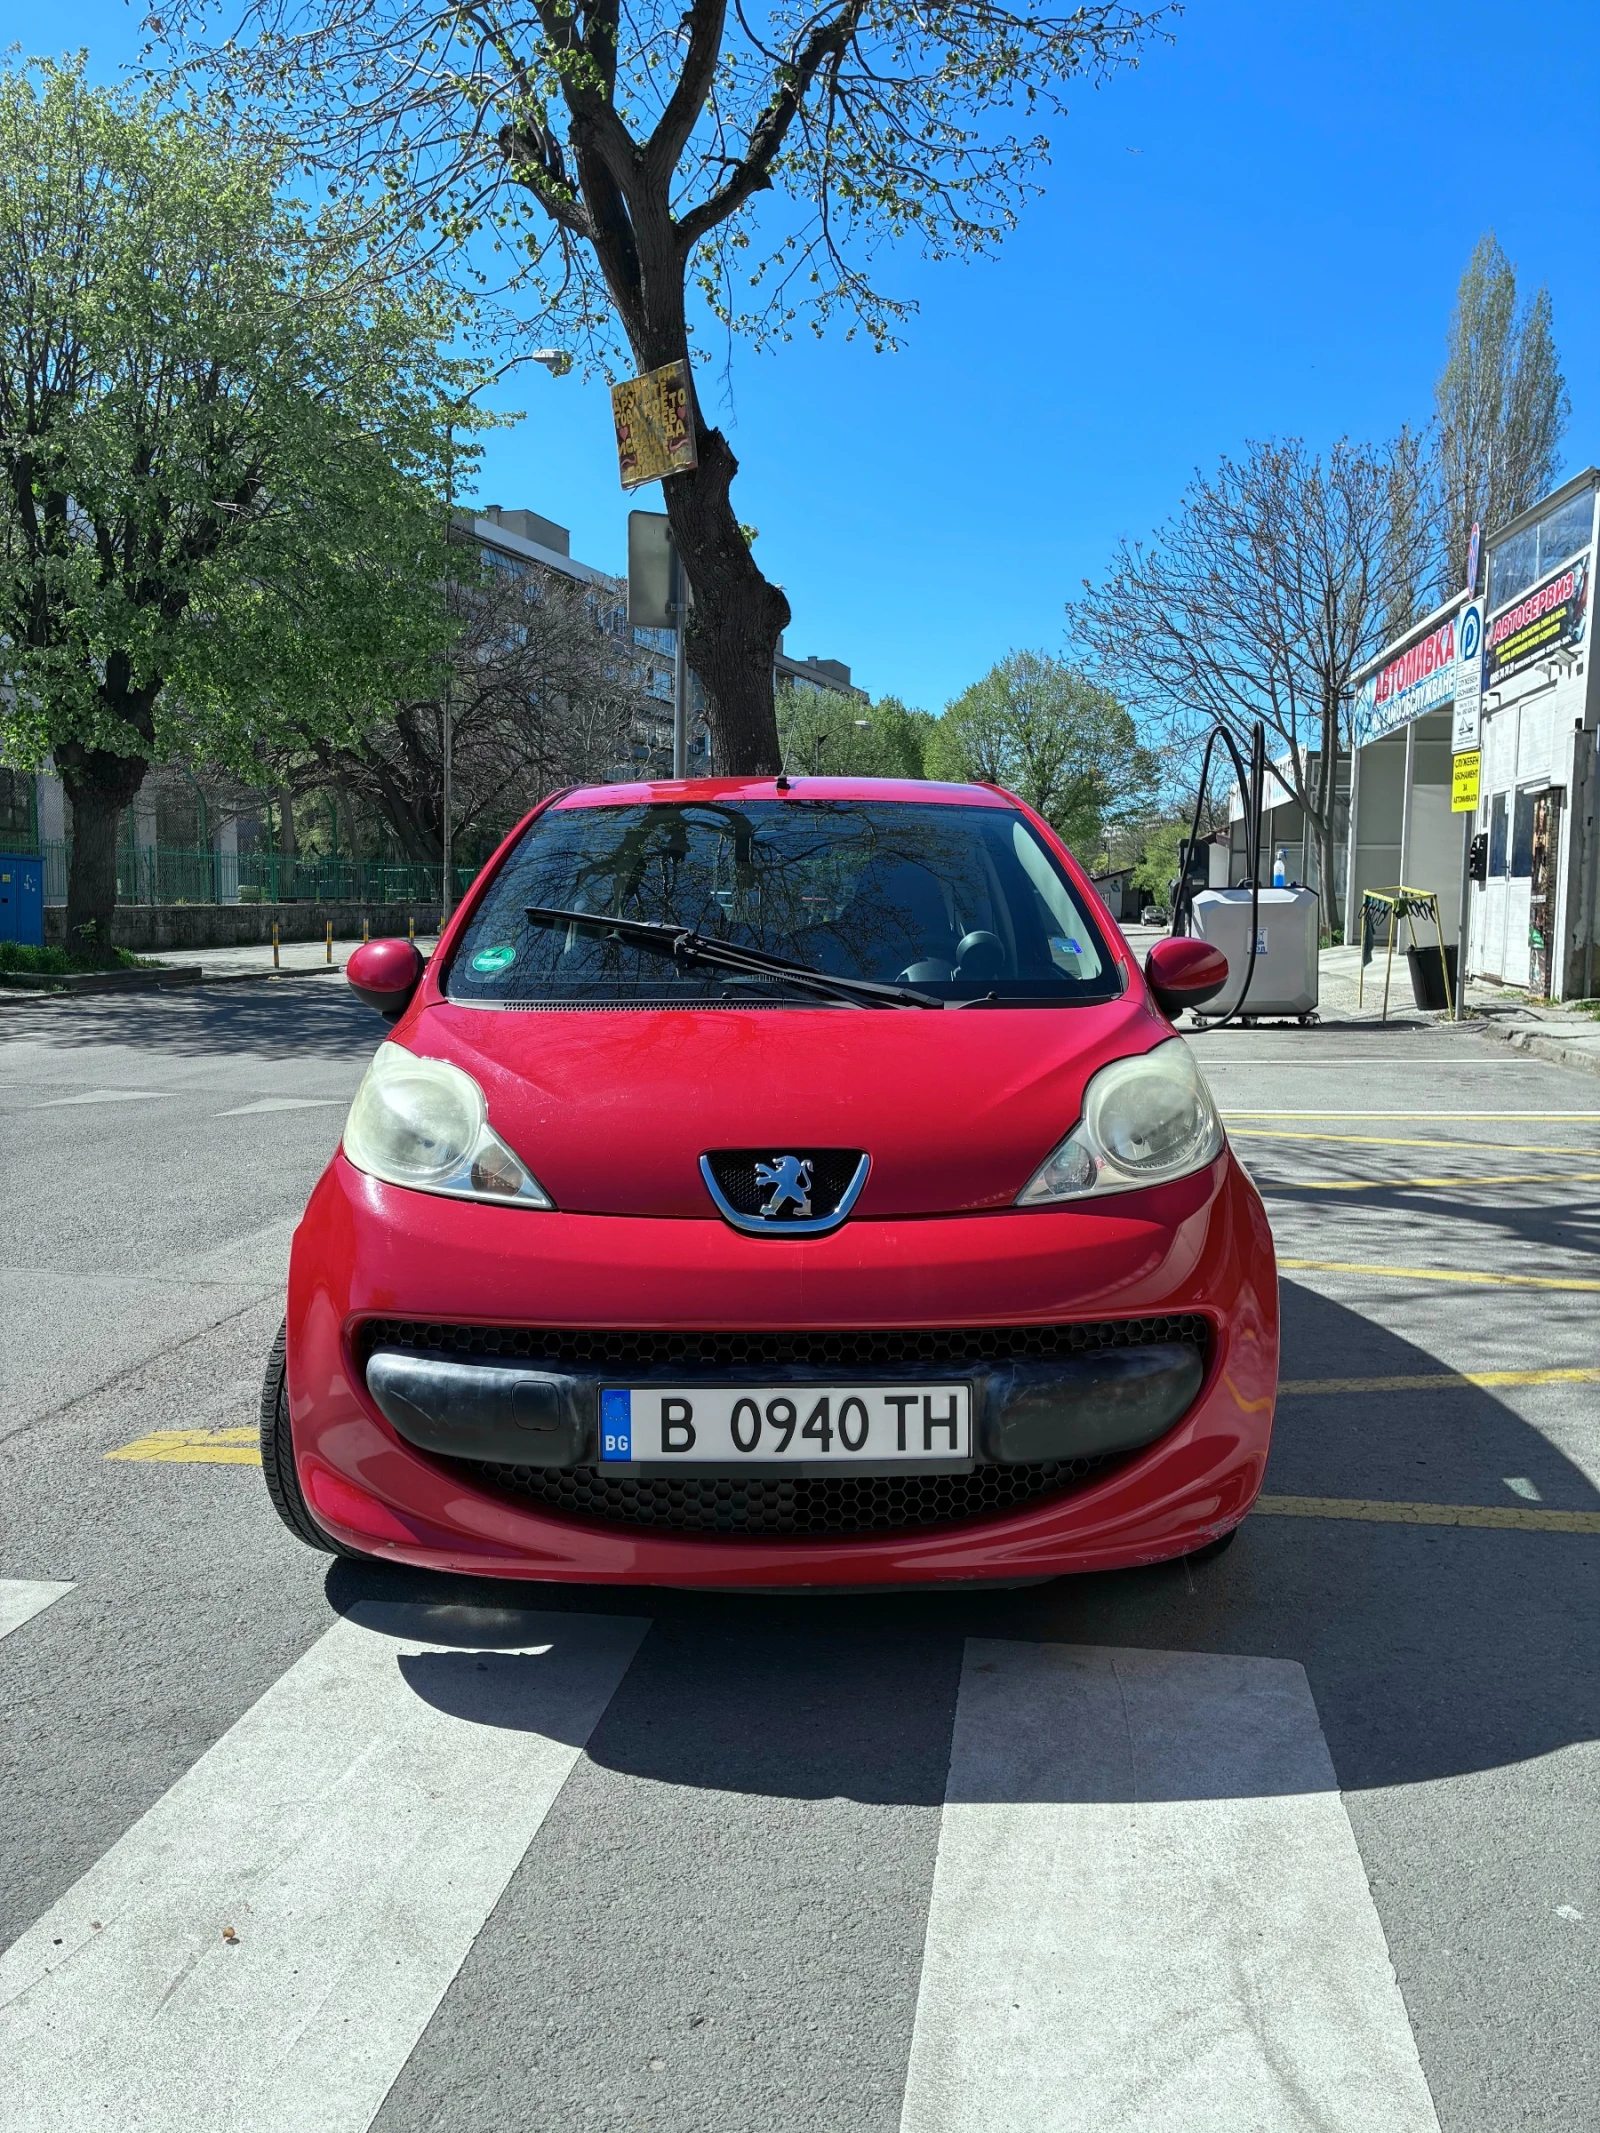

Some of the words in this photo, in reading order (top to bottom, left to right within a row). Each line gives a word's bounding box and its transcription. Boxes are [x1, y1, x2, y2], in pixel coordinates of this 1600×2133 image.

[657, 367, 677, 381] НА
[615, 407, 640, 429] ТОВА
[643, 388, 687, 418] КОЕТО
[630, 419, 648, 438] НА
[653, 408, 677, 429] ТЕБ
[665, 423, 686, 439] ДА
[1492, 571, 1575, 645] АВТОСЕРВИЗ
[1373, 619, 1455, 707] АВТОМИВКА
[1383, 667, 1455, 722] САМООБСЛУЖВАНЕ
[605, 1435, 629, 1452] BG
[660, 1397, 697, 1453] B
[730, 1396, 870, 1453] 0940
[884, 1395, 958, 1451] TH
